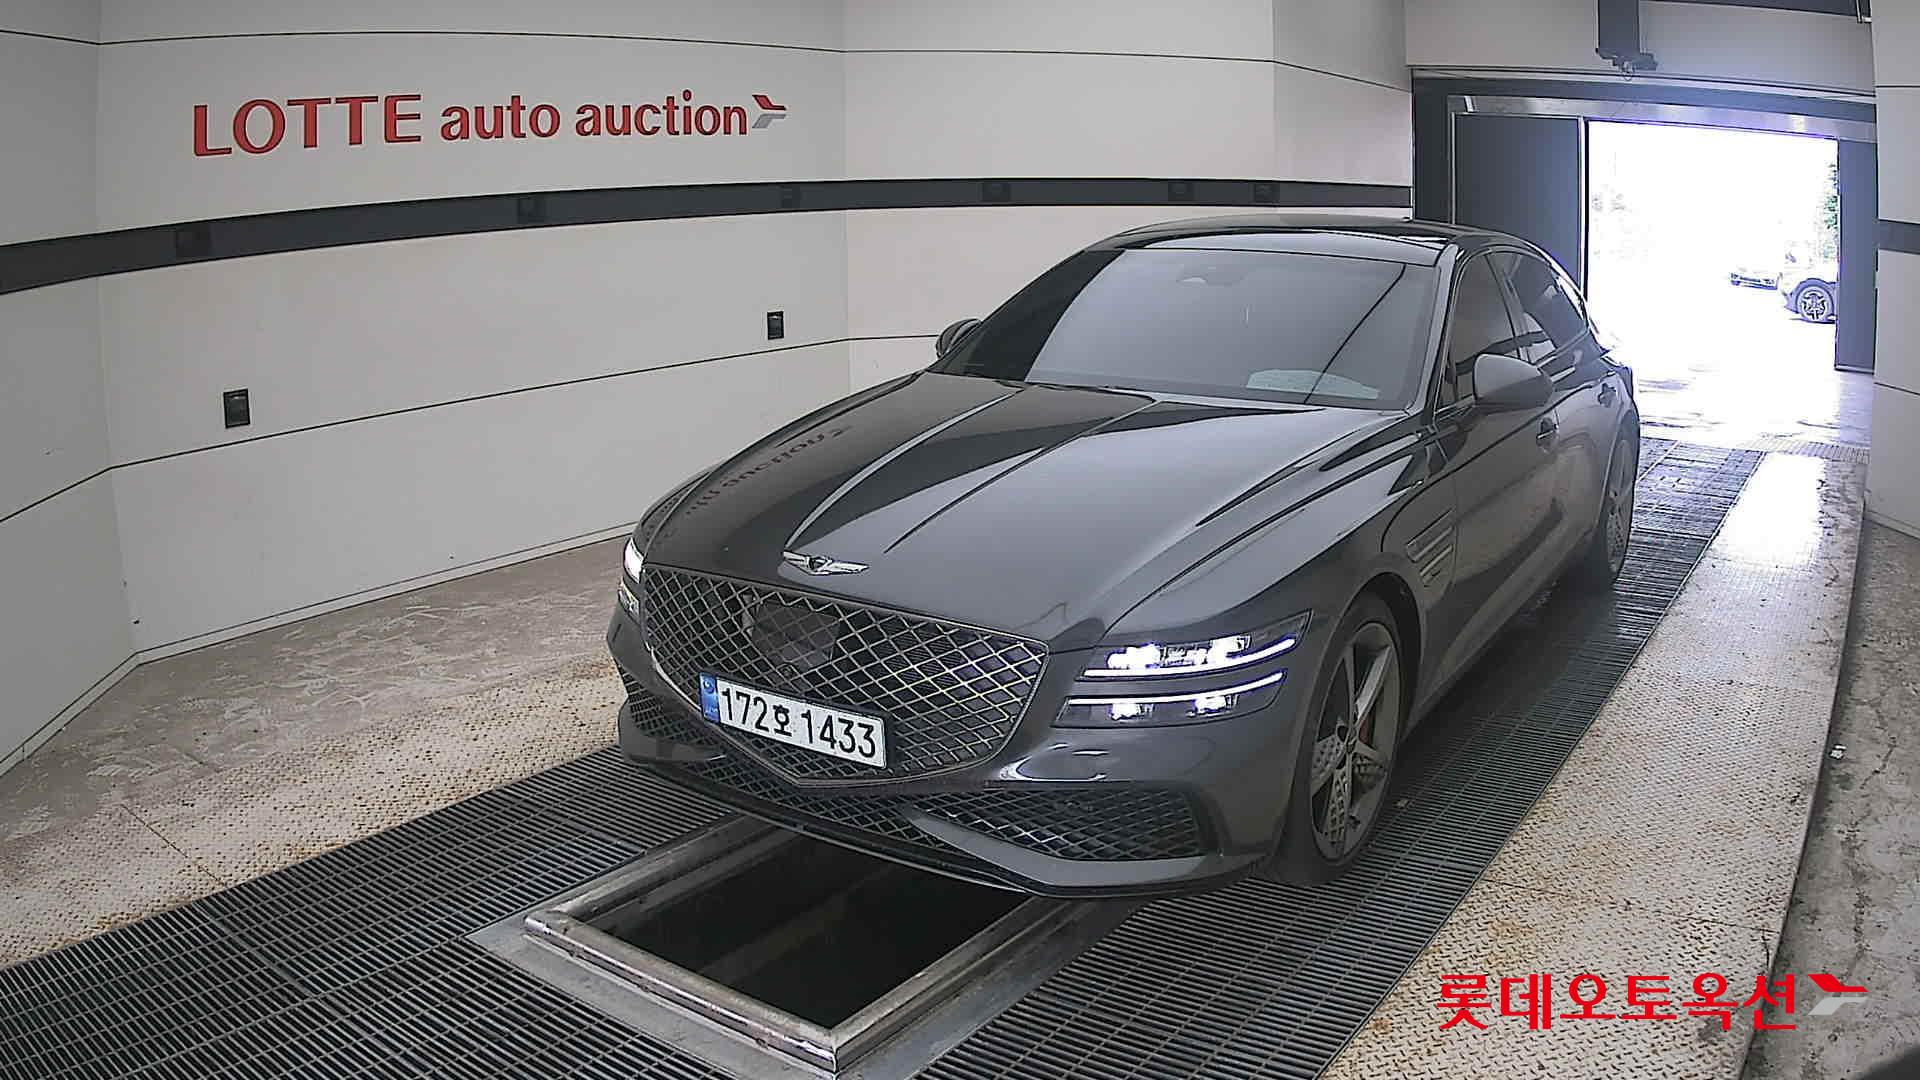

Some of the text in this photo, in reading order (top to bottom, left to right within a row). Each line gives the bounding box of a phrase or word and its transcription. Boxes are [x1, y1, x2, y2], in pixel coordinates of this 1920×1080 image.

[193, 89, 749, 157] LOTTE auto auction
[721, 686, 877, 759] 172호 1433
